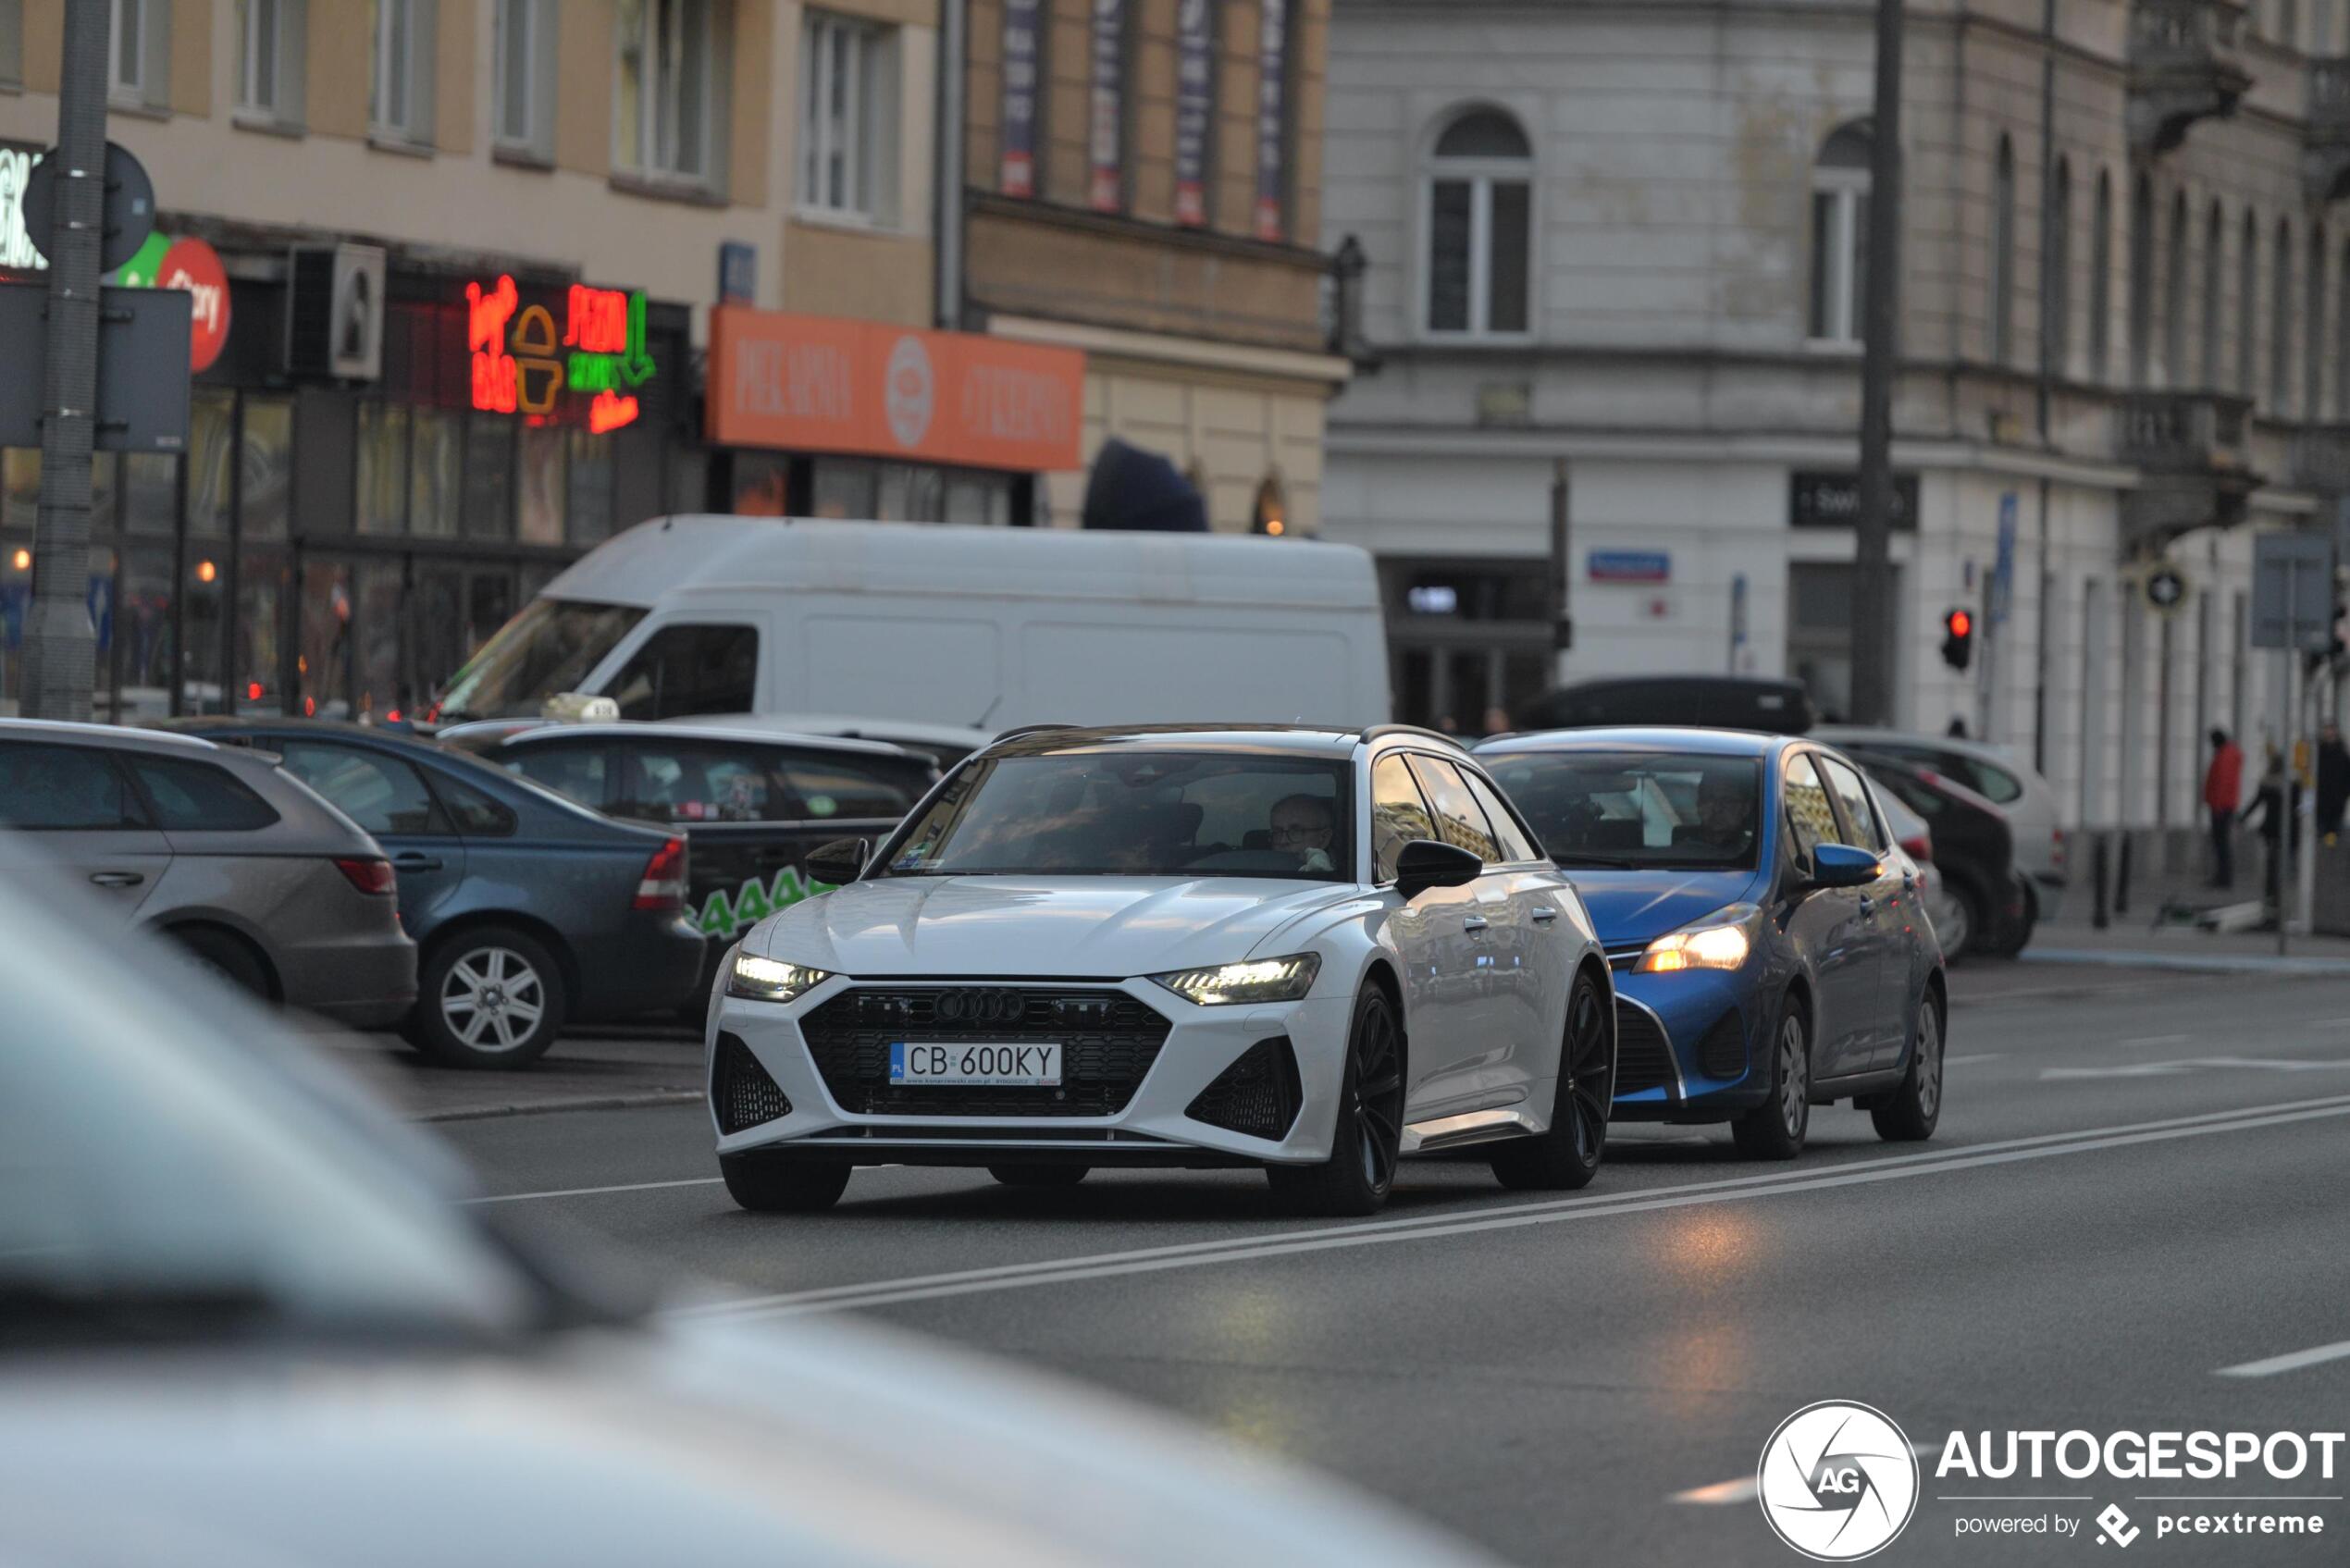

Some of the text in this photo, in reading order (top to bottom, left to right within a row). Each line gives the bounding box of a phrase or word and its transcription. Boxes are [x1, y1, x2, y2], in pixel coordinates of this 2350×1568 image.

[892, 1064, 903, 1073] PL
[911, 1047, 1052, 1075] CB 600KY
